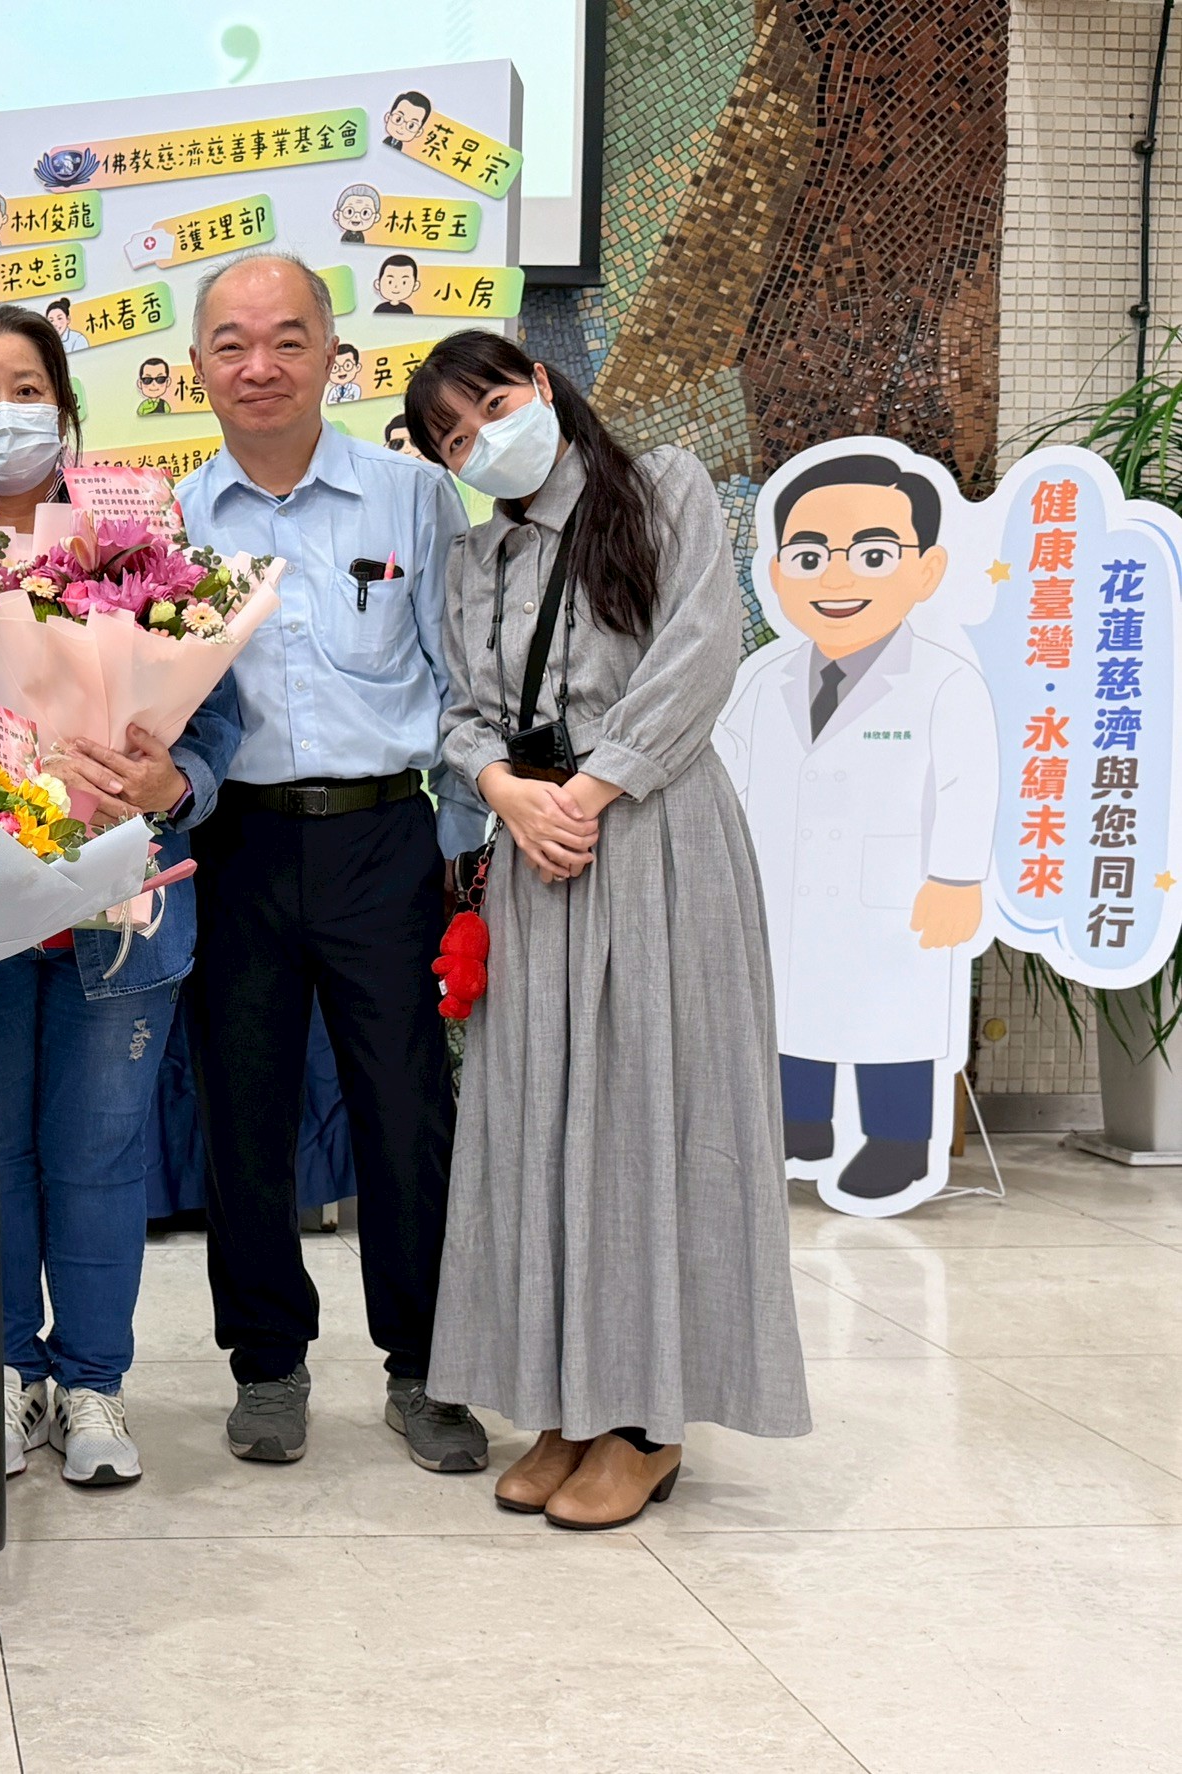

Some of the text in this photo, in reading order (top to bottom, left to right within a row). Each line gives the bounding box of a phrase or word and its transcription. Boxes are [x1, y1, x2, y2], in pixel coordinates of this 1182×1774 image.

[102, 119, 358, 175] 佛教慈濟慈善事業基金會
[421, 122, 511, 187] 蔡昇宗
[11, 201, 95, 233] 林俊龍
[176, 206, 266, 253] 護理部
[384, 207, 468, 241] 林碧玉
[0, 253, 78, 292] 梁忠詔
[432, 276, 495, 309] 小房
[85, 291, 162, 334] 林春香
[1086, 558, 1148, 949] 花蓮慈濟與您同行
